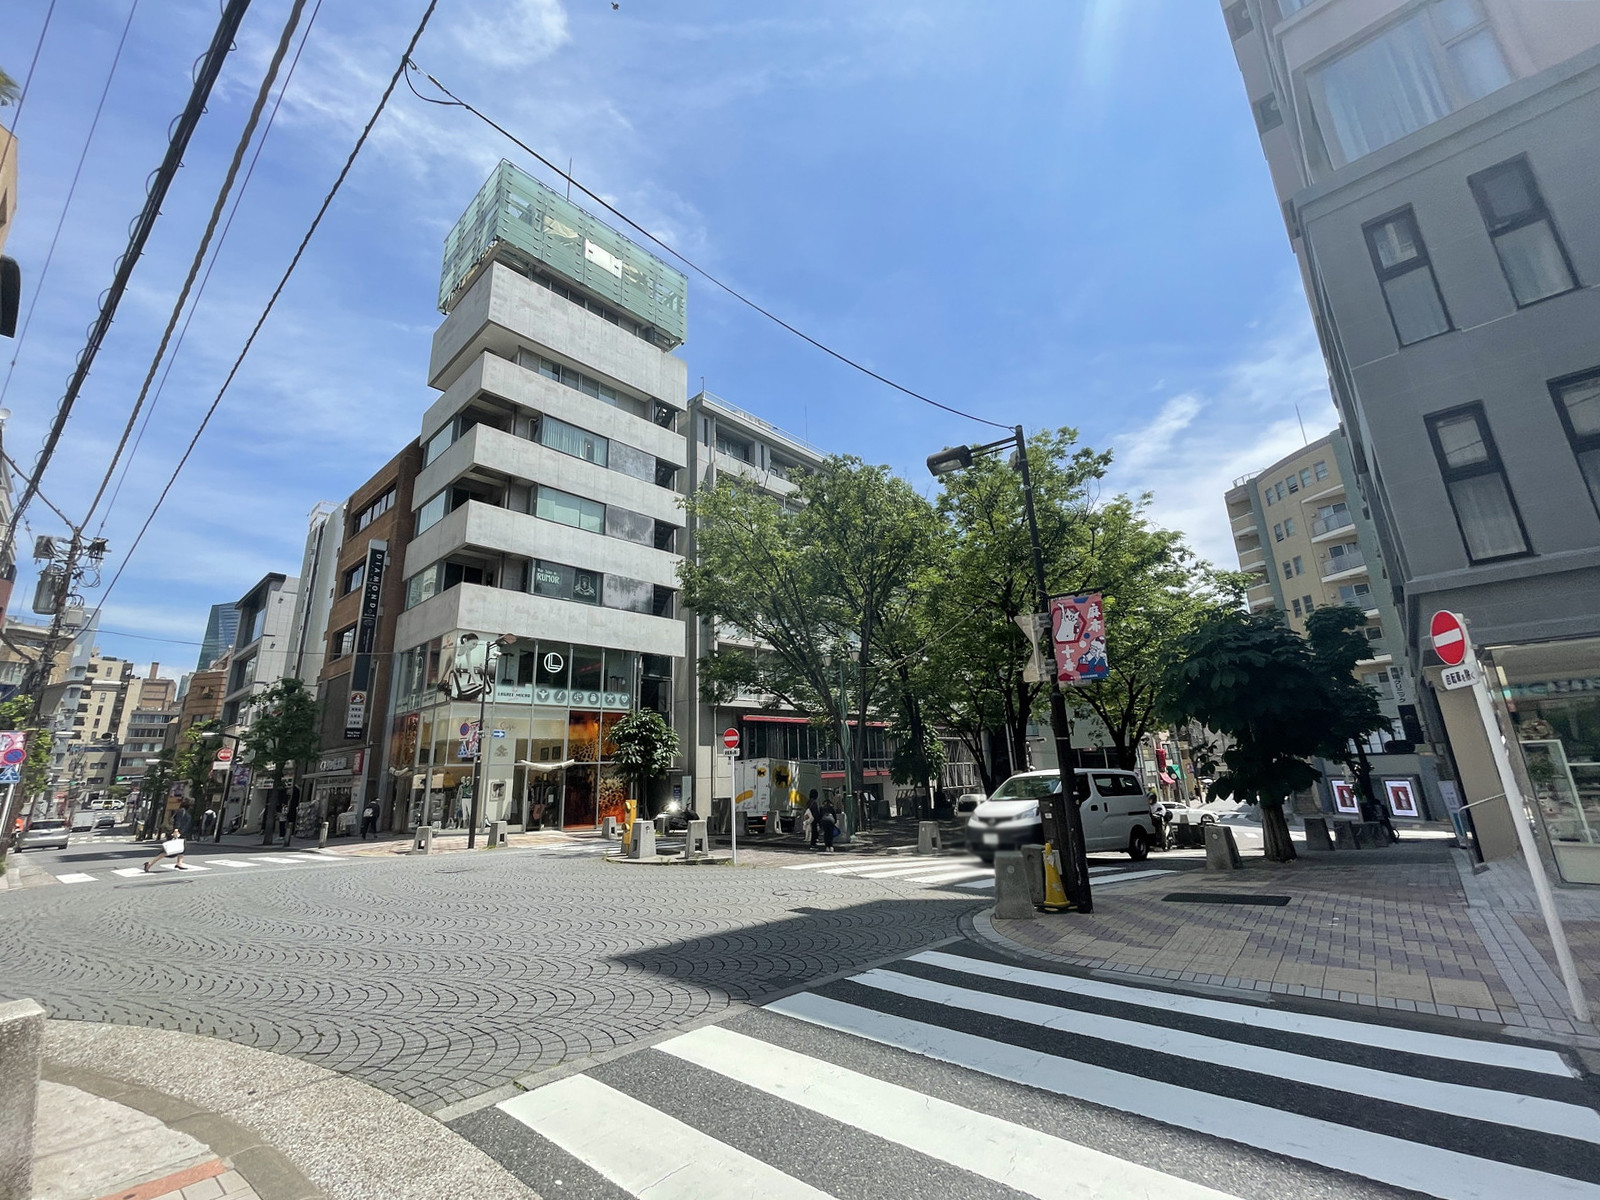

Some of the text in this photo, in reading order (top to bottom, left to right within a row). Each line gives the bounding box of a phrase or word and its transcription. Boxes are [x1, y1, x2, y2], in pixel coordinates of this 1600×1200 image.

[370, 553, 383, 609] DIAMOND
[536, 572, 560, 584] RUMOR
[1087, 603, 1102, 633] 麻布
